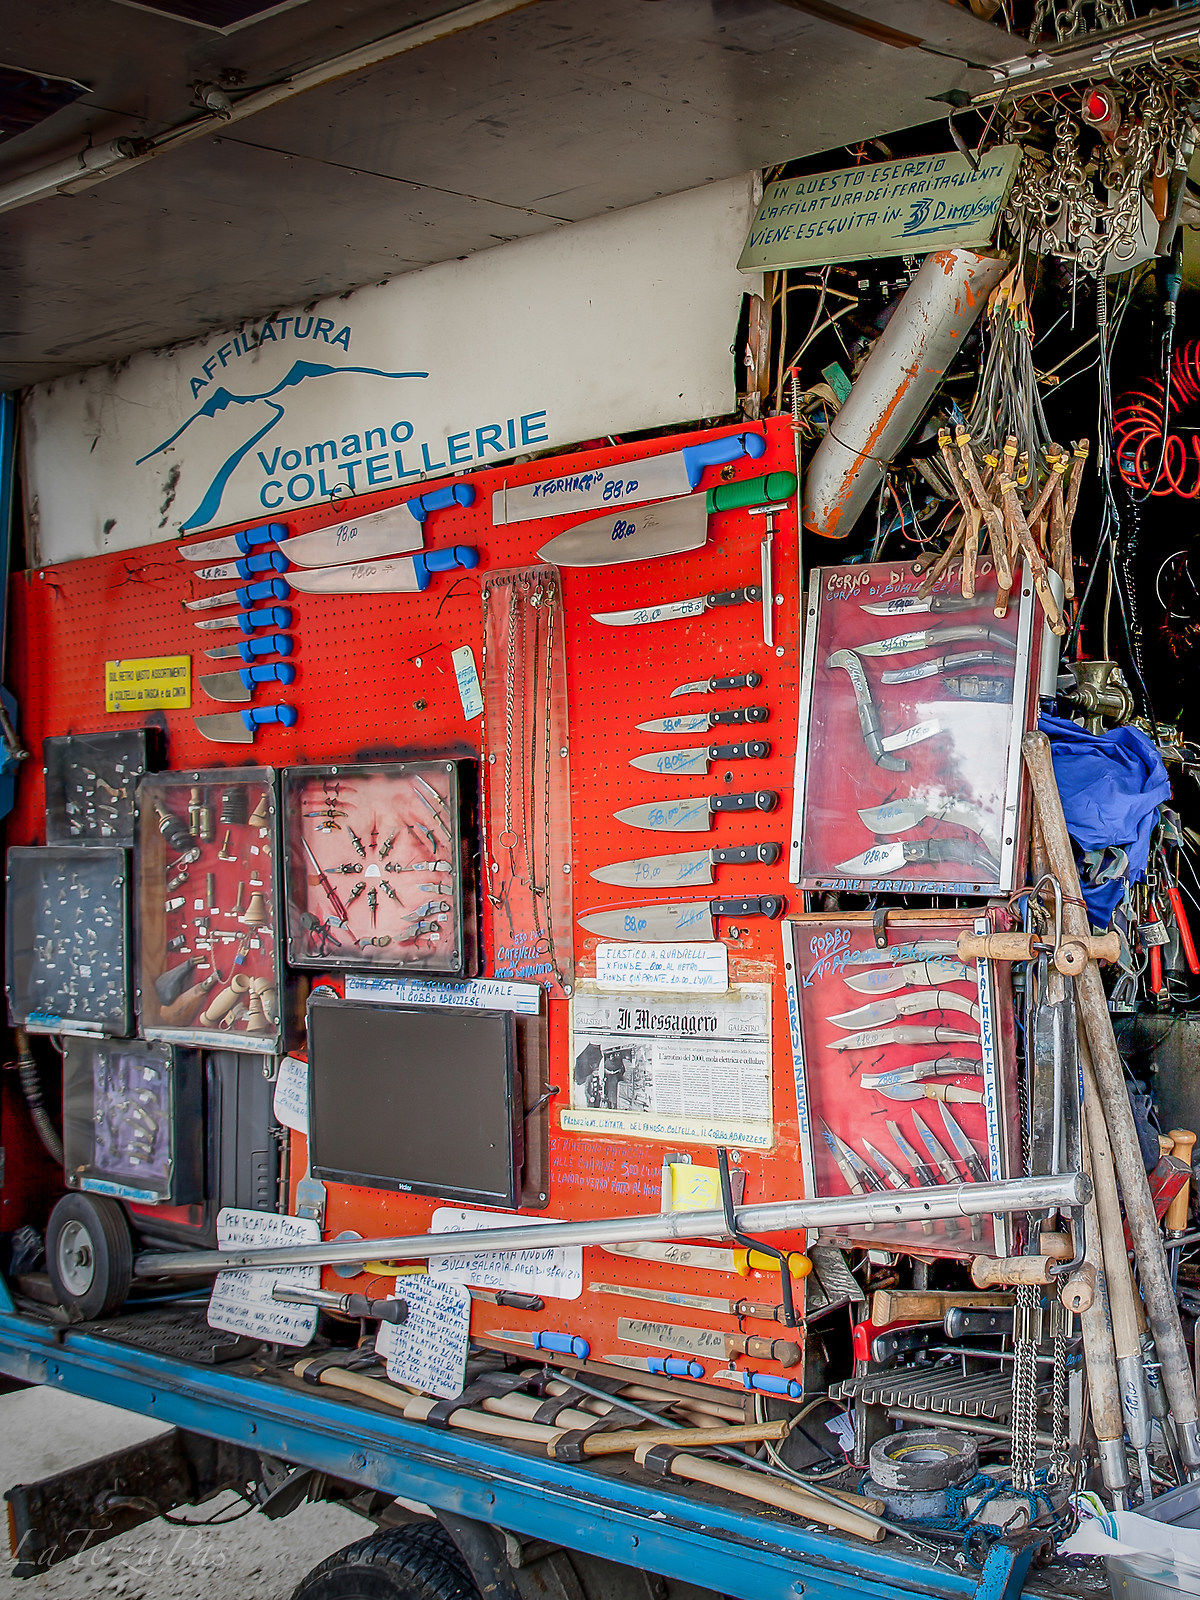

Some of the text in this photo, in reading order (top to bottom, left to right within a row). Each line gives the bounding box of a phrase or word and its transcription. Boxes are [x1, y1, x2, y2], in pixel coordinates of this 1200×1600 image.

[758, 191, 862, 221] L'AFFILATURA
[890, 176, 932, 200] FERRI
[933, 161, 1006, 189] TAGLIENTI
[773, 182, 790, 200] IN
[795, 171, 866, 197] QUESTO
[749, 226, 794, 248] VIENE
[795, 211, 877, 240] ESEGUITA
[188, 315, 352, 400] AFFILATURA
[256, 419, 415, 477] Vomano
[259, 410, 550, 509] COLTELLERIE
[616, 1007, 633, 1031] Il
[633, 1008, 719, 1035] Messaggero
